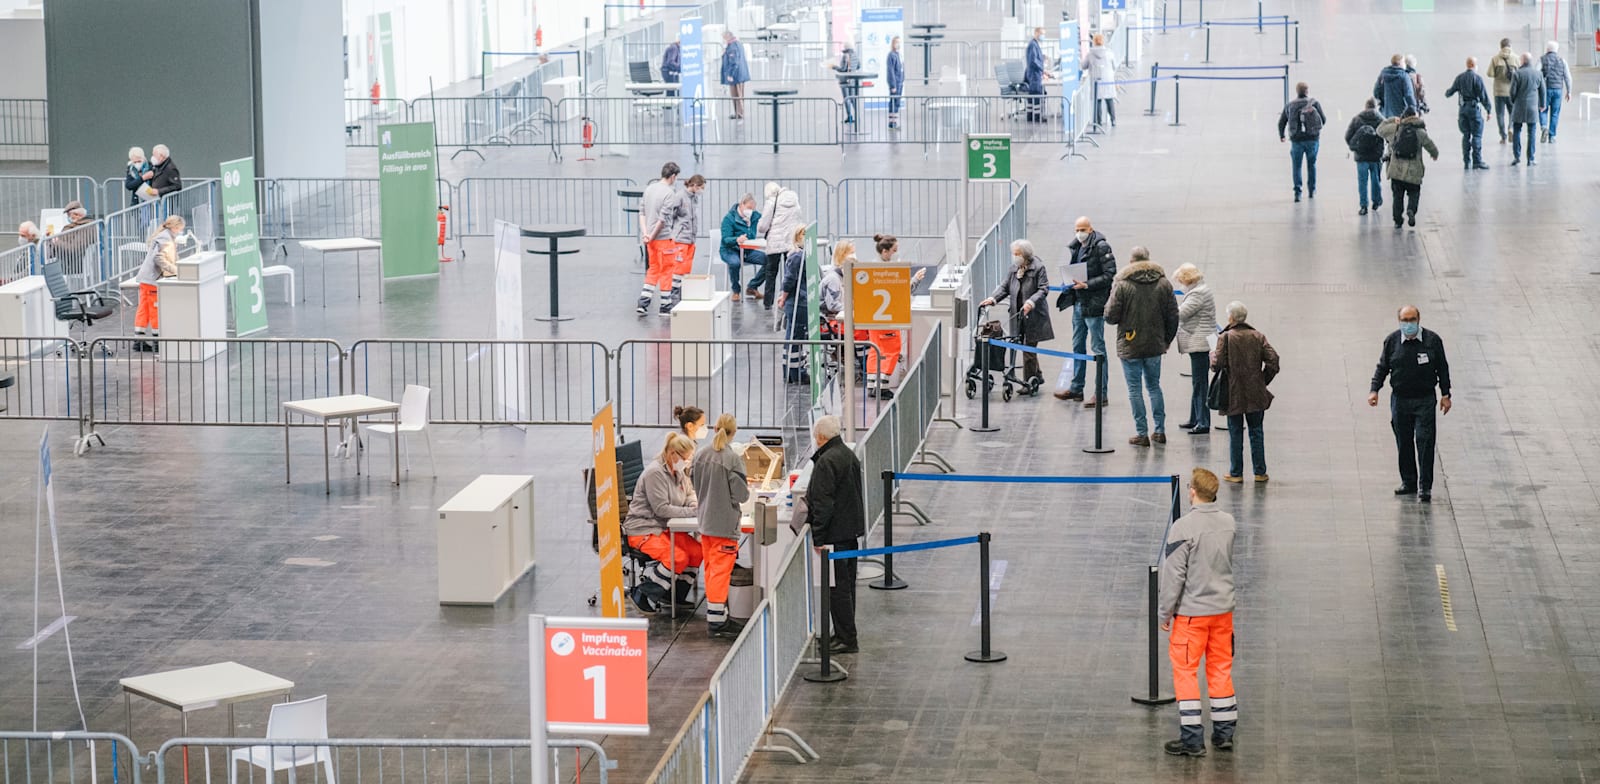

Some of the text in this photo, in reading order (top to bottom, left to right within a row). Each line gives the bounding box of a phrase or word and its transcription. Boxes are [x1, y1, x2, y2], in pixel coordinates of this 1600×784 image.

[382, 149, 431, 160] Ausfüllbereich
[382, 163, 427, 175] Filling in area
[982, 153, 997, 178] 3
[873, 270, 899, 279] Impfung
[248, 266, 263, 314] 3
[872, 289, 893, 321] 2
[582, 632, 627, 646] Impfung
[582, 645, 642, 657] Vaccination
[583, 665, 607, 720] 1
